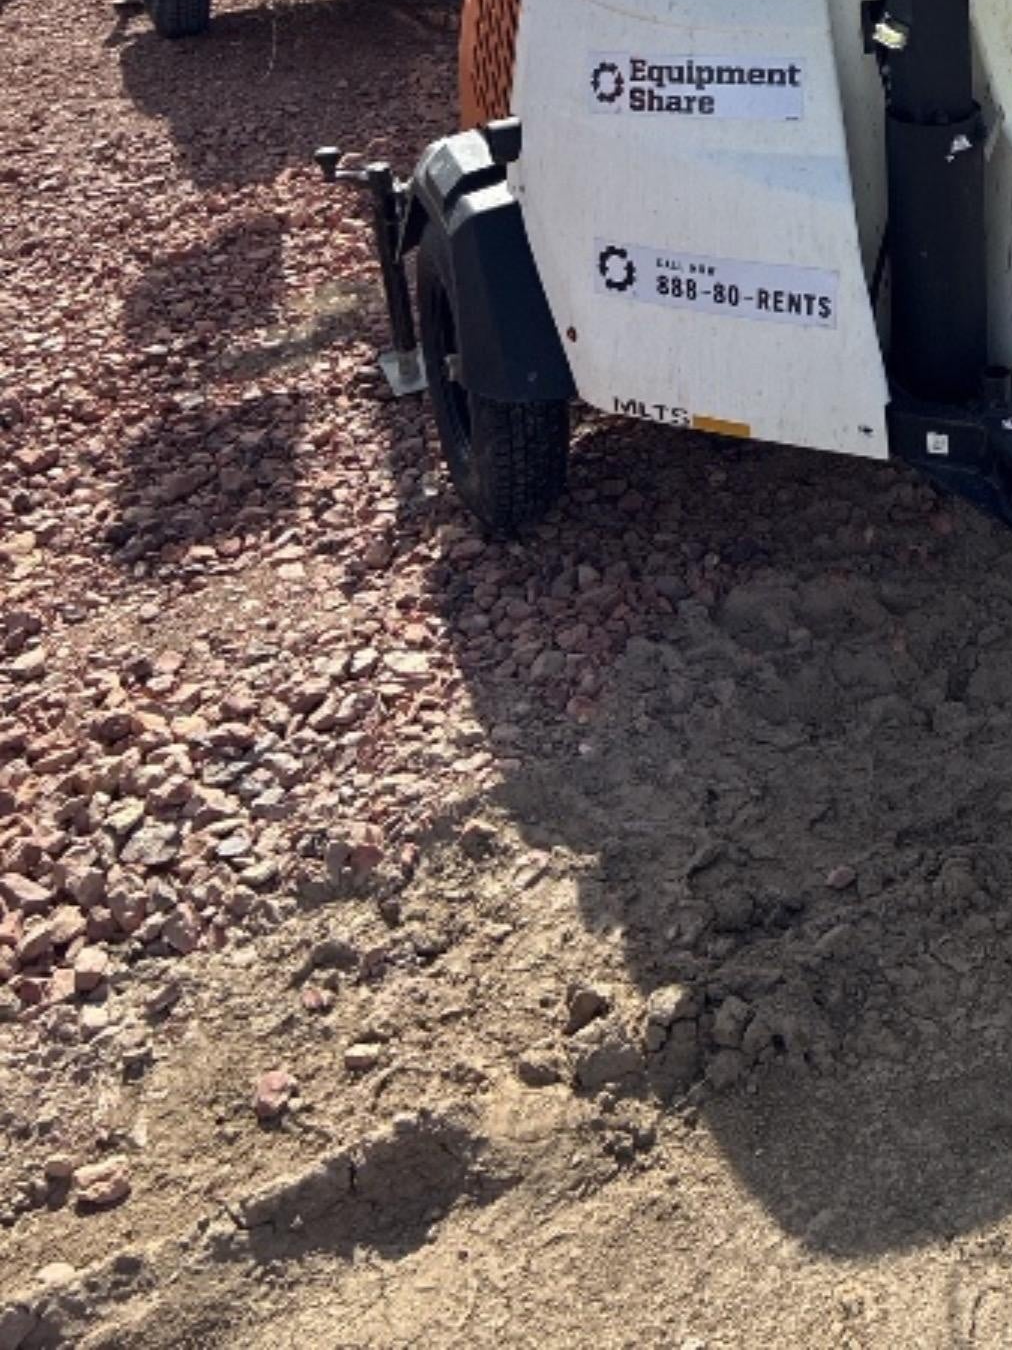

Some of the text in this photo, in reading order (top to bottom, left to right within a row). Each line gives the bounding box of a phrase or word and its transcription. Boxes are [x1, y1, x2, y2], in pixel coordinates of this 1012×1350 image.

[629, 58, 802, 90] Equipment
[629, 87, 715, 115] Share
[656, 275, 833, 319] 888-80-RENTS
